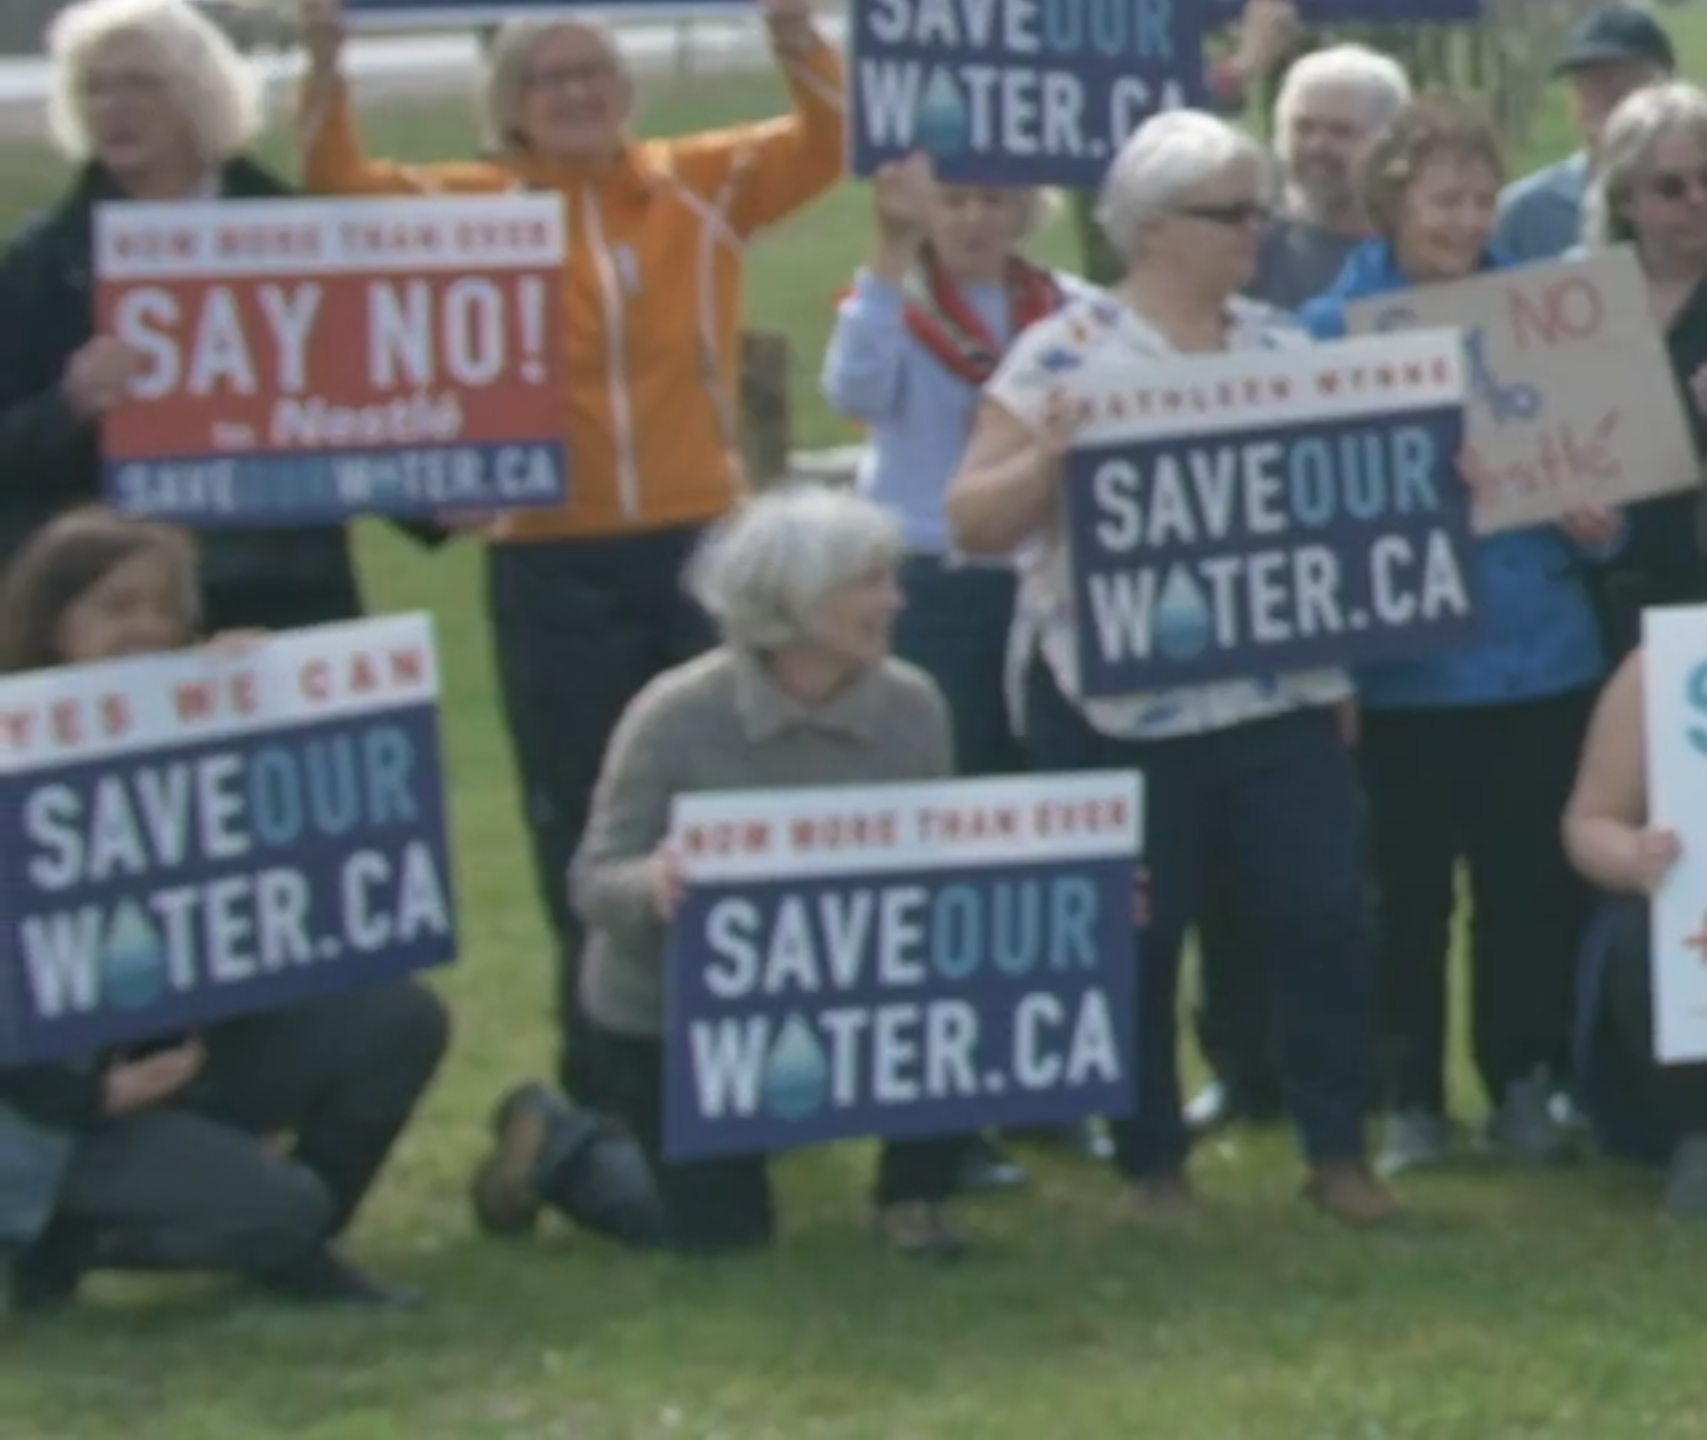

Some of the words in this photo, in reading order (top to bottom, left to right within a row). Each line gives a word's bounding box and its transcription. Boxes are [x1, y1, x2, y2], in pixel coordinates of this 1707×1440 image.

[115, 284, 322, 400] SAY
[366, 275, 547, 389] NO!
[1507, 275, 1605, 351] NO
[270, 392, 462, 449] Nestlé
[0, 693, 130, 747] YES
[172, 669, 259, 723] WE
[300, 647, 423, 704] CAN
[686, 821, 772, 856] NOW
[792, 812, 897, 849] MORE
[918, 804, 1020, 841] THAN
[1033, 797, 1128, 837] EVER
